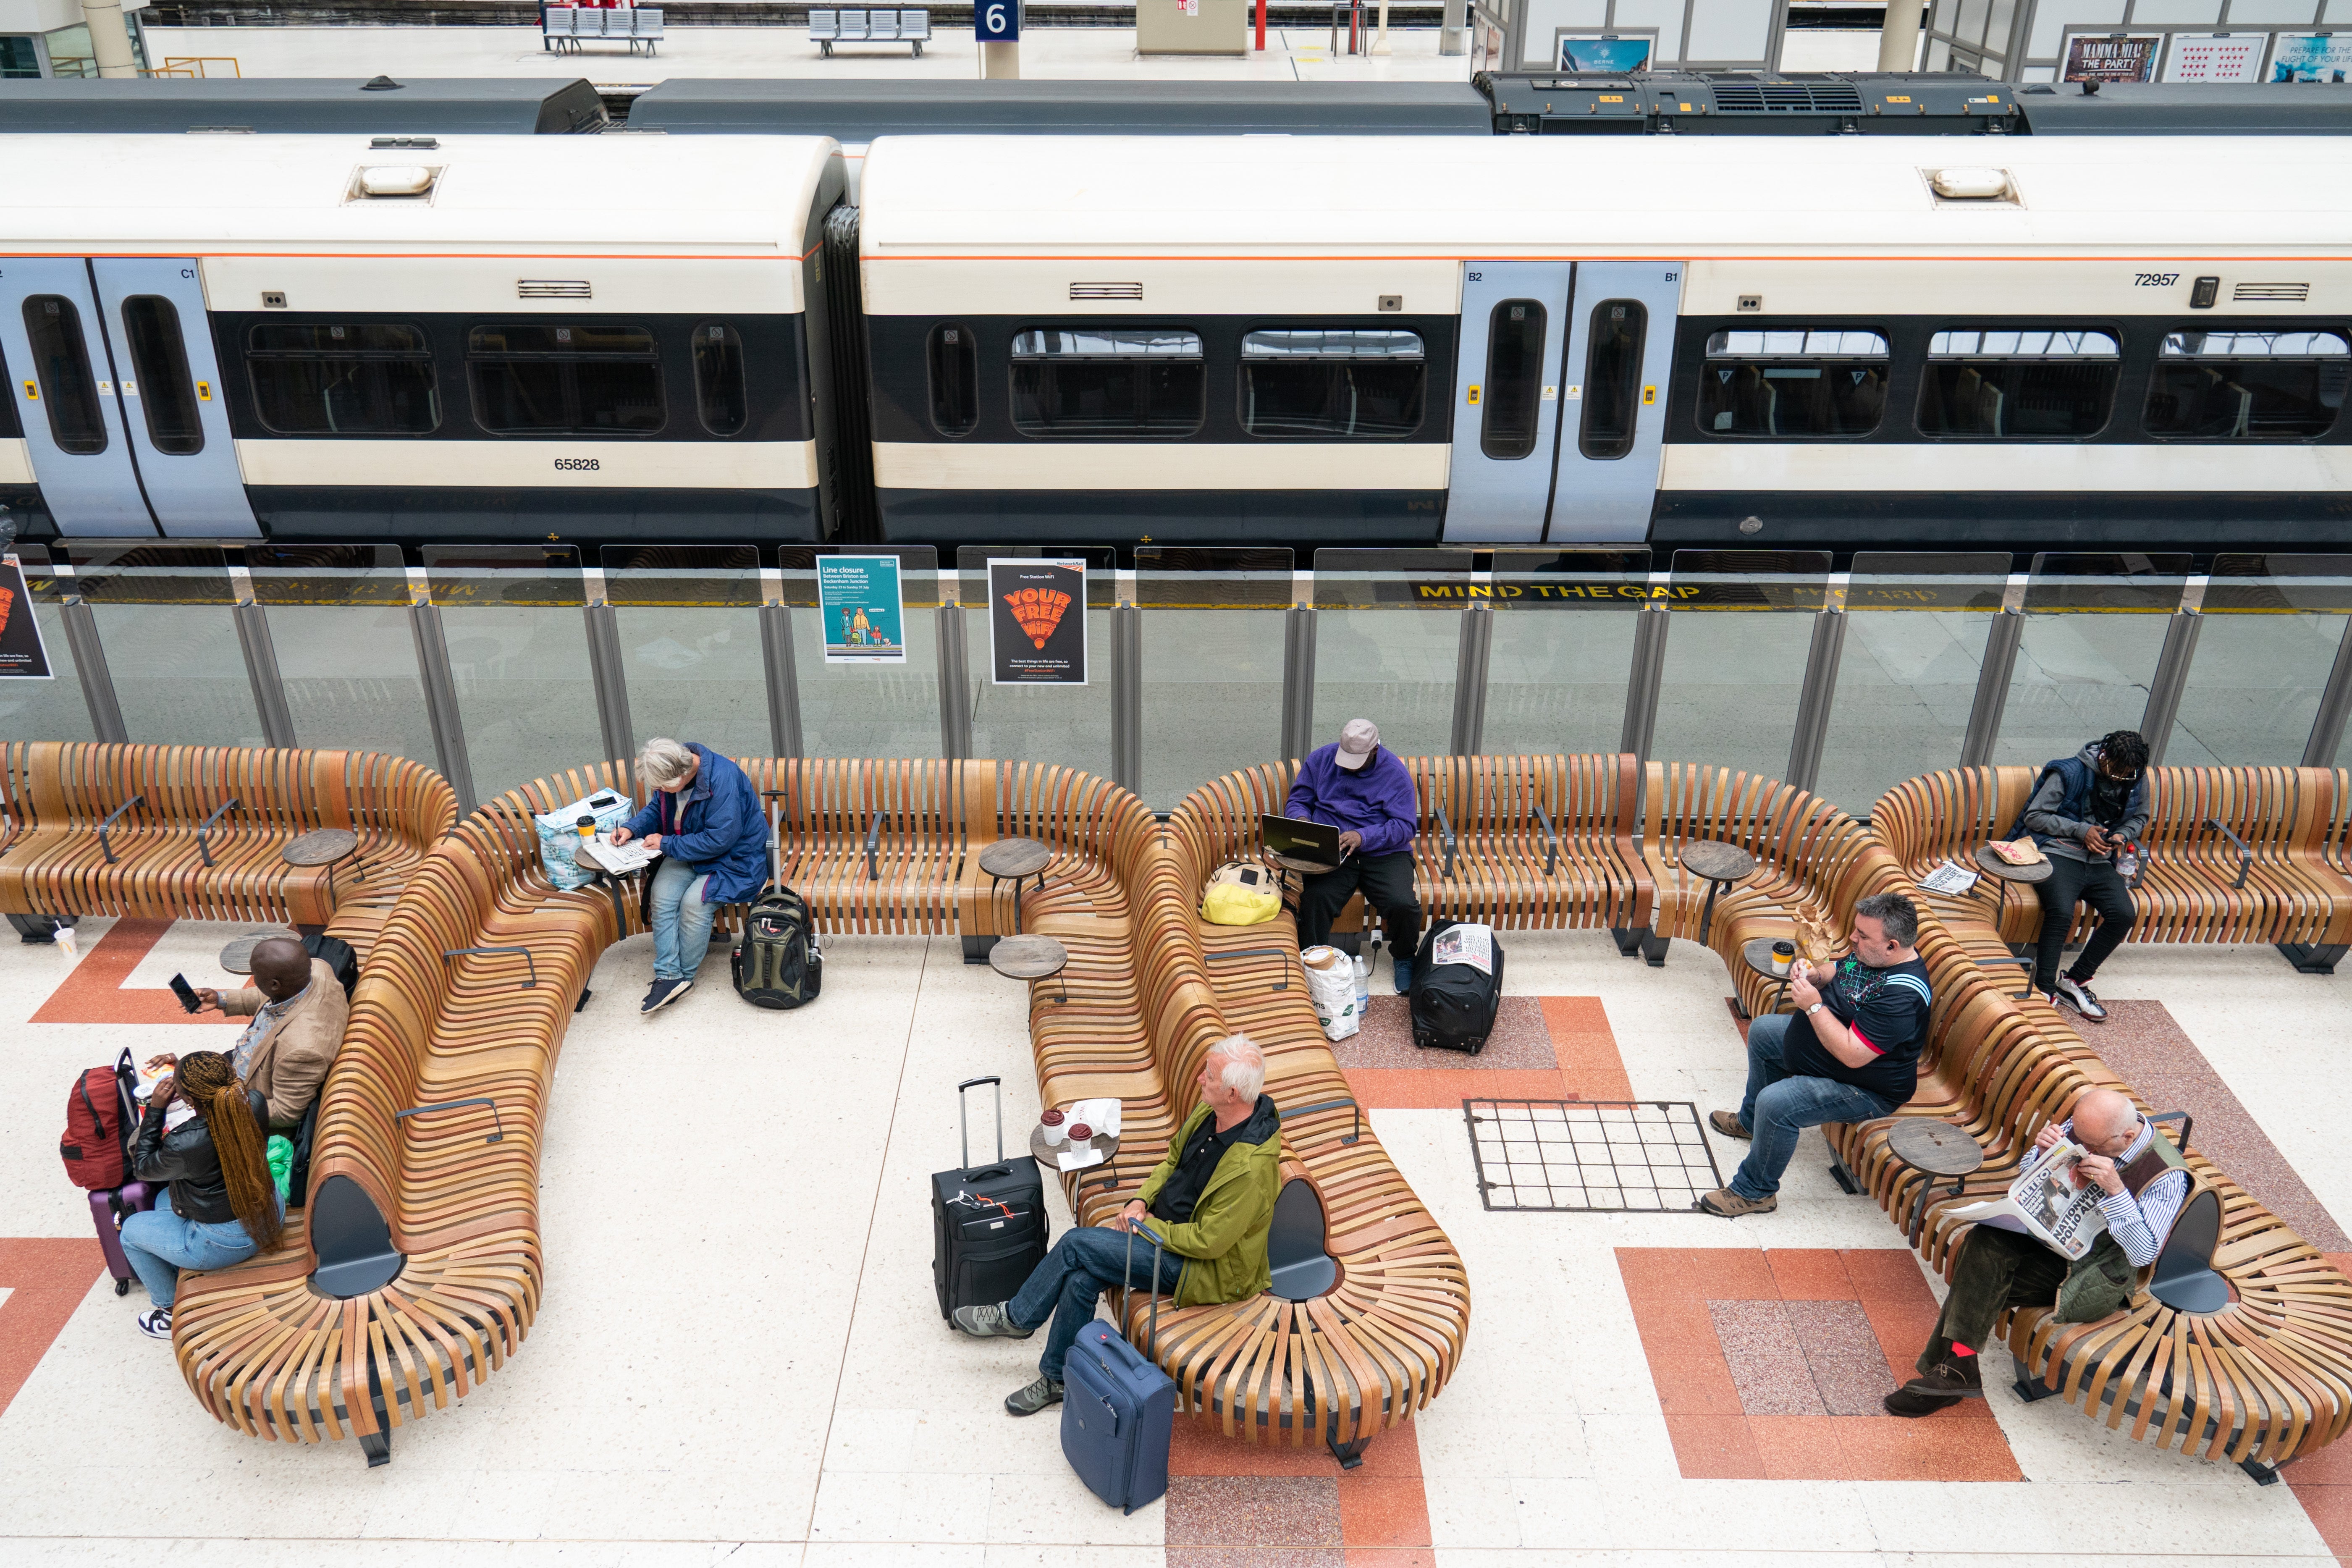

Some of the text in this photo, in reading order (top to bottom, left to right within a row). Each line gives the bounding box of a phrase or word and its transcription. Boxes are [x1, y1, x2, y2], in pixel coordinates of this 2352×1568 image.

[986, 4, 1006, 33] 6
[2081, 43, 2142, 58] MAMMA MIA!
[2082, 59, 2136, 68] THE PARTY
[181, 269, 194, 279] C1
[1468, 272, 1482, 282] B2
[1665, 273, 1678, 282] B1
[2134, 273, 2180, 286] 72957
[1722, 371, 1729, 380] P
[1855, 371, 1862, 380] P
[554, 459, 600, 470] 65828
[1003, 588, 1071, 608] YOUR
[1419, 586, 1700, 598] MIND THE GAP
[1011, 603, 1065, 622] FREE
[1021, 621, 1057, 636] WiFi
[1926, 865, 1954, 887] NATIONWIDE
[1932, 869, 1960, 889] POLIO ALERT
[2019, 1169, 2049, 1204] METRO
[2024, 1198, 2037, 1210] Royals
[2028, 1195, 2045, 1214] Windrush
[2032, 1203, 2045, 1217] tribute
[2053, 1183, 2100, 1240] NATIONWID
[2059, 1214, 2081, 1245] POLIO
[2080, 1188, 2106, 1215] ALER
